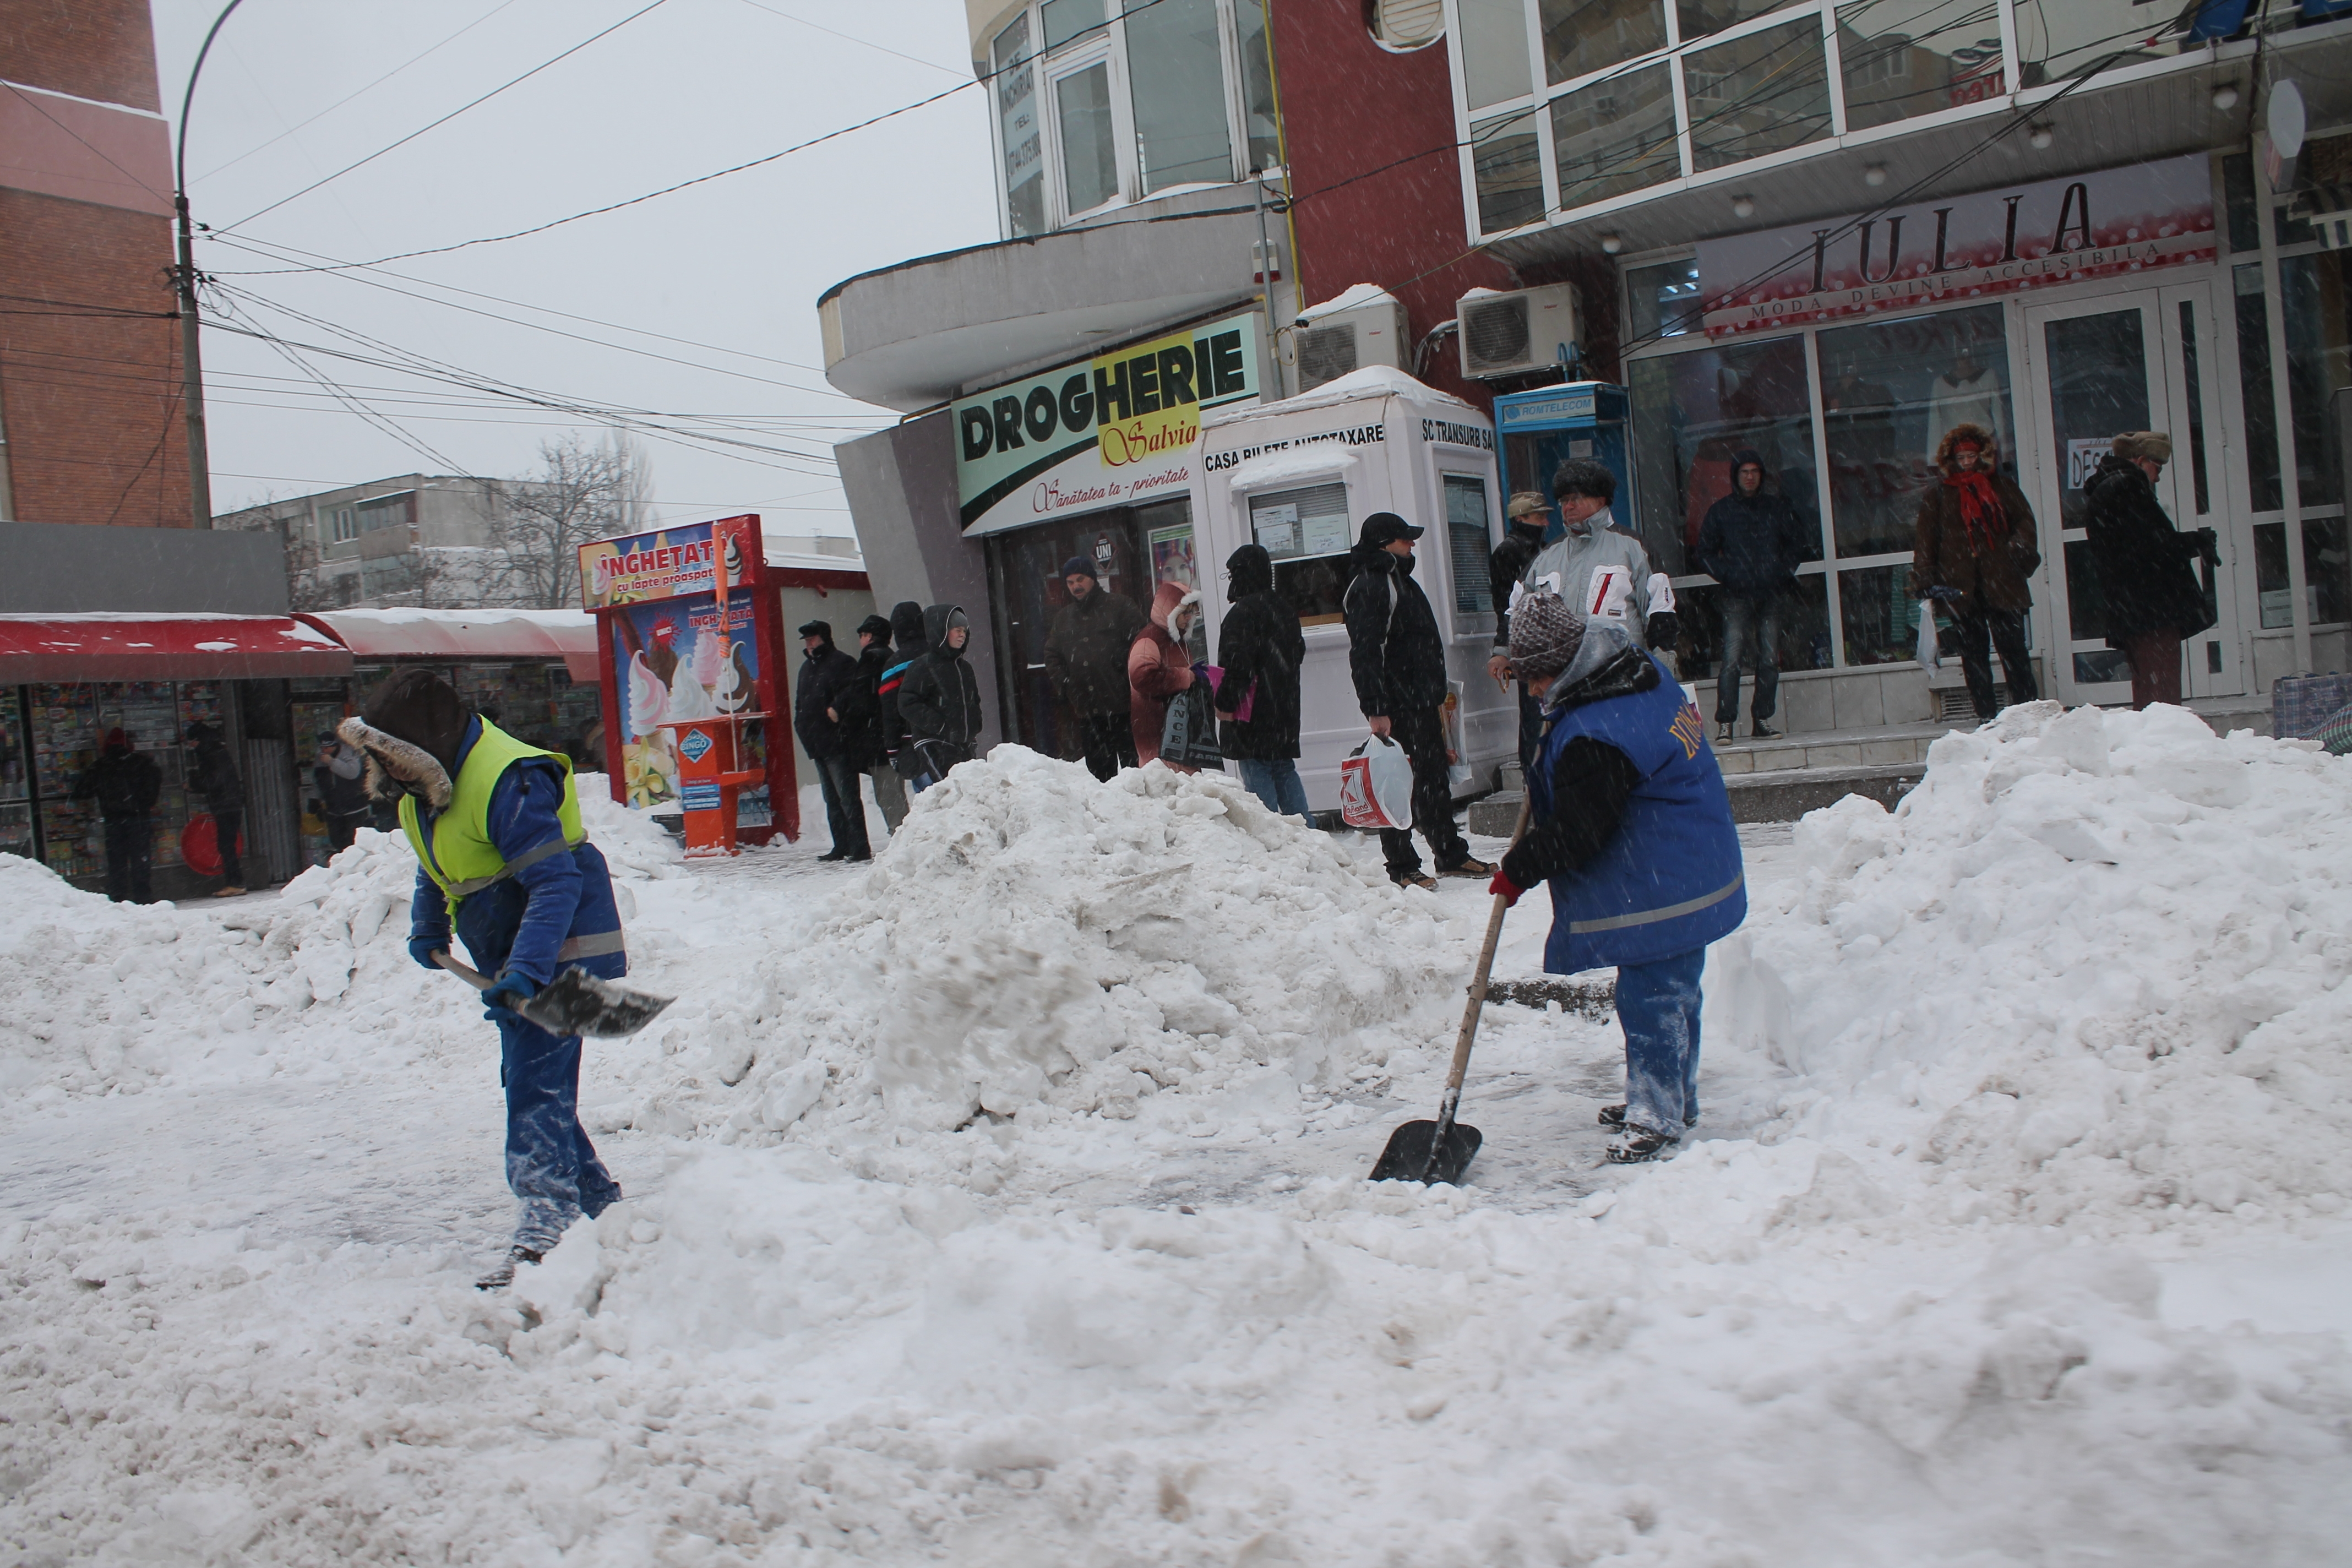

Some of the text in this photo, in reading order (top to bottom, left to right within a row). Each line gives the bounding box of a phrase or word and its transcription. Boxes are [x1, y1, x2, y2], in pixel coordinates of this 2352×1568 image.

[1807, 182, 2096, 295] IULIA
[1751, 243, 2159, 319] MODA DEVINE ACCESIBILA
[960, 329, 1245, 462] DROGHERIE
[1522, 399, 1591, 416] ROMTELECOM
[1103, 420, 1197, 467] Salvia
[1422, 418, 1494, 451] SC TRANSURB SA
[1205, 451, 1239, 472] CASA
[1032, 478, 1106, 513] Sănătatea
[1108, 482, 1121, 496] ta
[1129, 466, 1189, 499] prioritate
[600, 532, 728, 579] ÎNGHEȚAT
[1096, 543, 1112, 559] UNI
[617, 582, 629, 594] cu
[631, 578, 660, 592] lapte
[680, 739, 706, 750] BINGO
